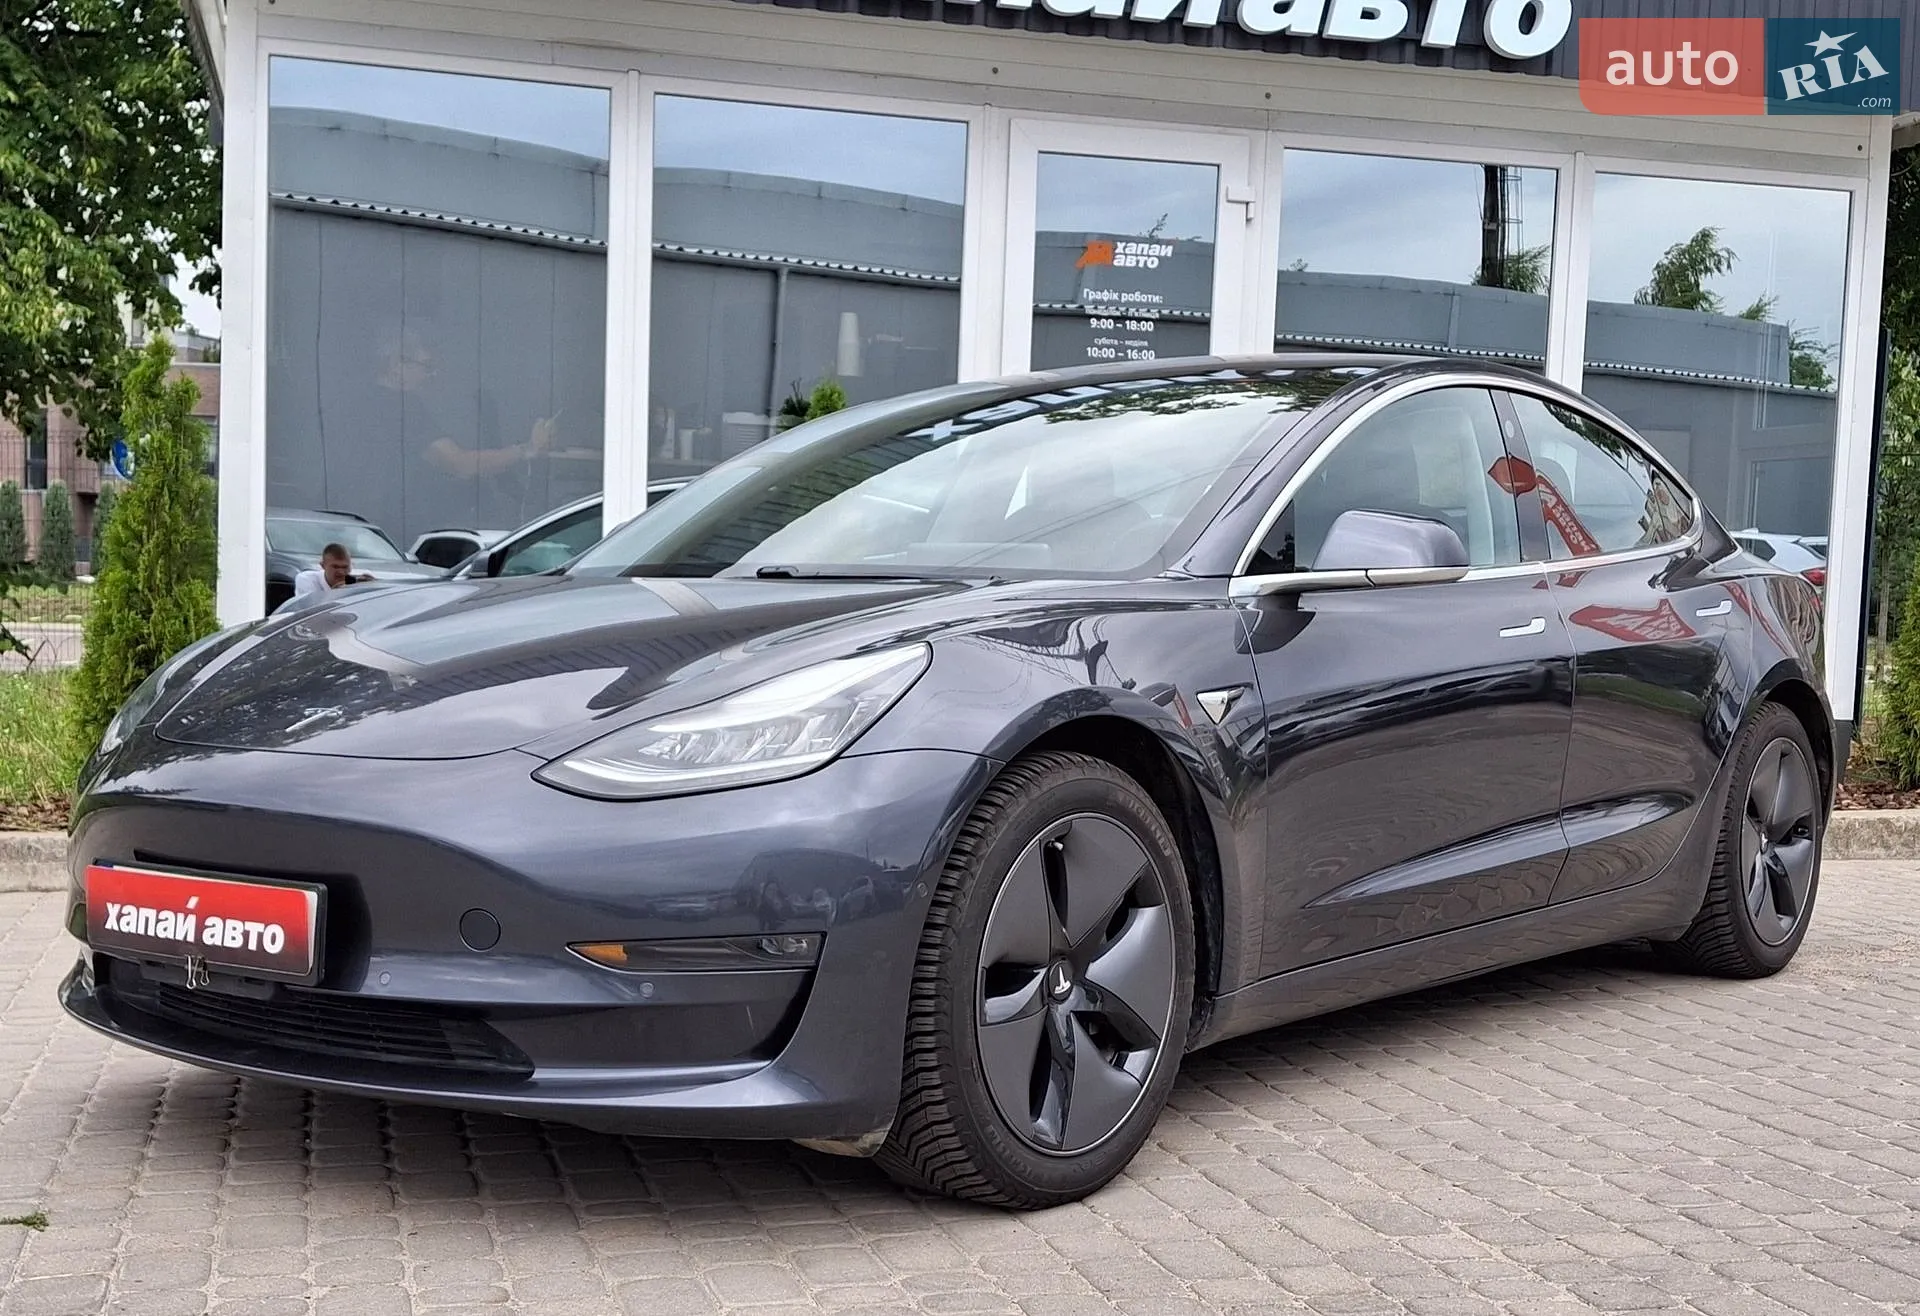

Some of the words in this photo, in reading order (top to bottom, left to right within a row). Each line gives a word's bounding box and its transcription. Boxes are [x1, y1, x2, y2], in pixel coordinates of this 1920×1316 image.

[1113, 254, 1160, 269] авто
[1083, 288, 1119, 302] Графік
[1120, 290, 1164, 304] роботи:
[1089, 318, 1114, 330] 9:00
[1125, 320, 1154, 332] 18:00
[1086, 346, 1116, 358] 10:00
[1126, 348, 1156, 360] 16:00
[104, 896, 200, 943] хапай
[202, 916, 285, 955] авто
